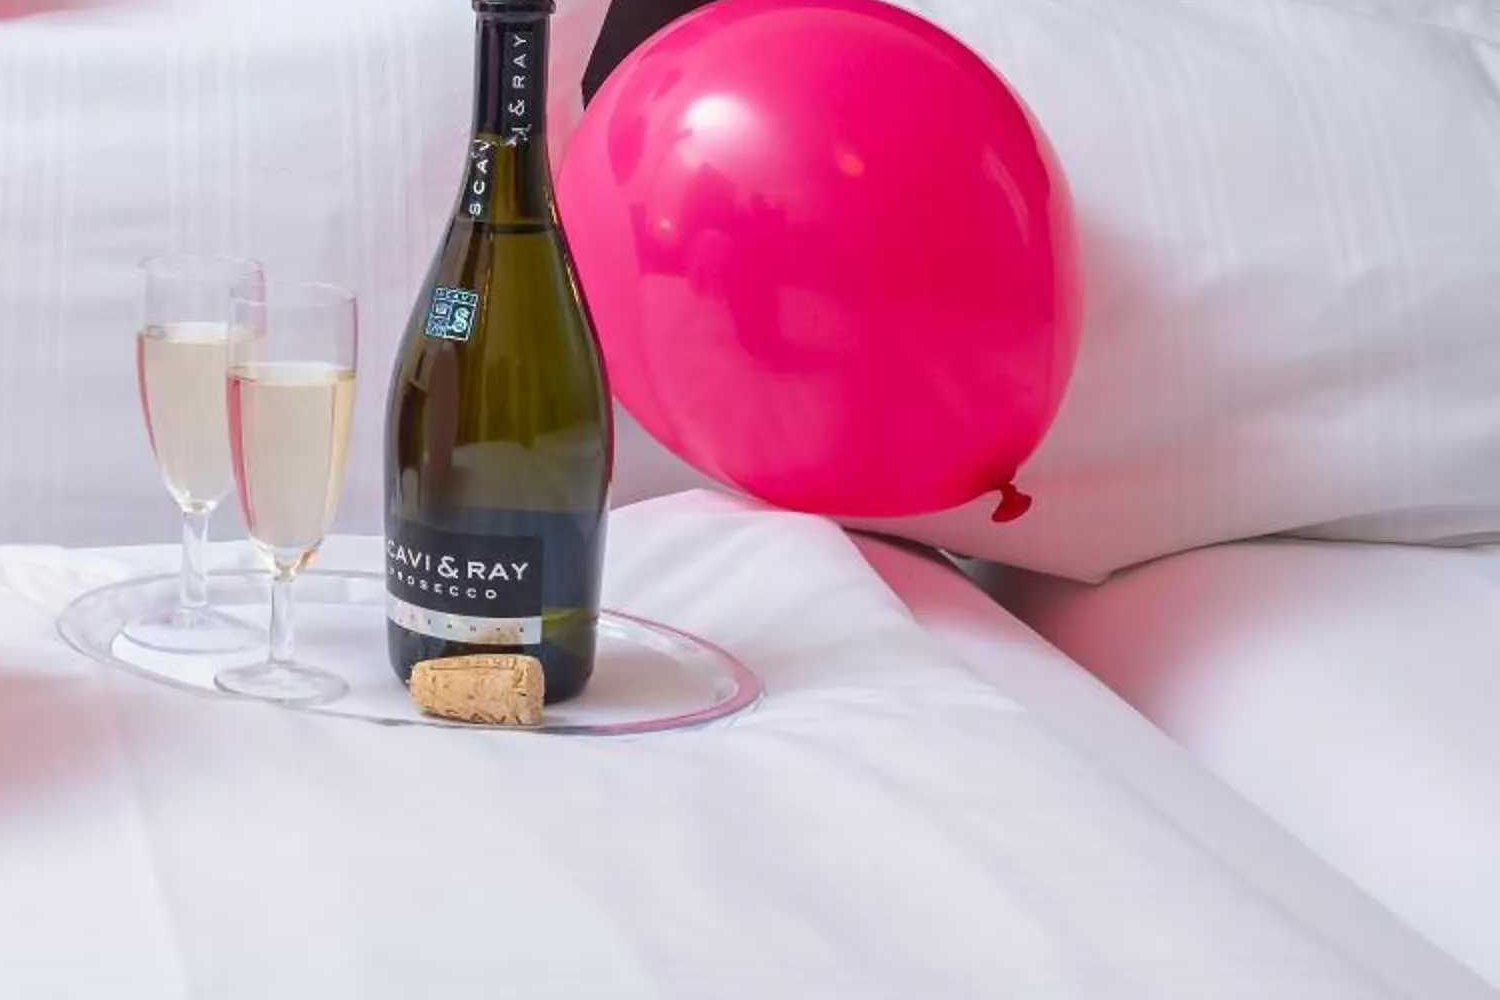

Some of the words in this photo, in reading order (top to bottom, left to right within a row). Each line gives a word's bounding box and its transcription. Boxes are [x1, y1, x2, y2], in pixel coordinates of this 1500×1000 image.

[512, 33, 527, 89] RAY
[508, 99, 525, 117] &
[437, 555, 459, 579] &
[467, 560, 529, 581] RAY
